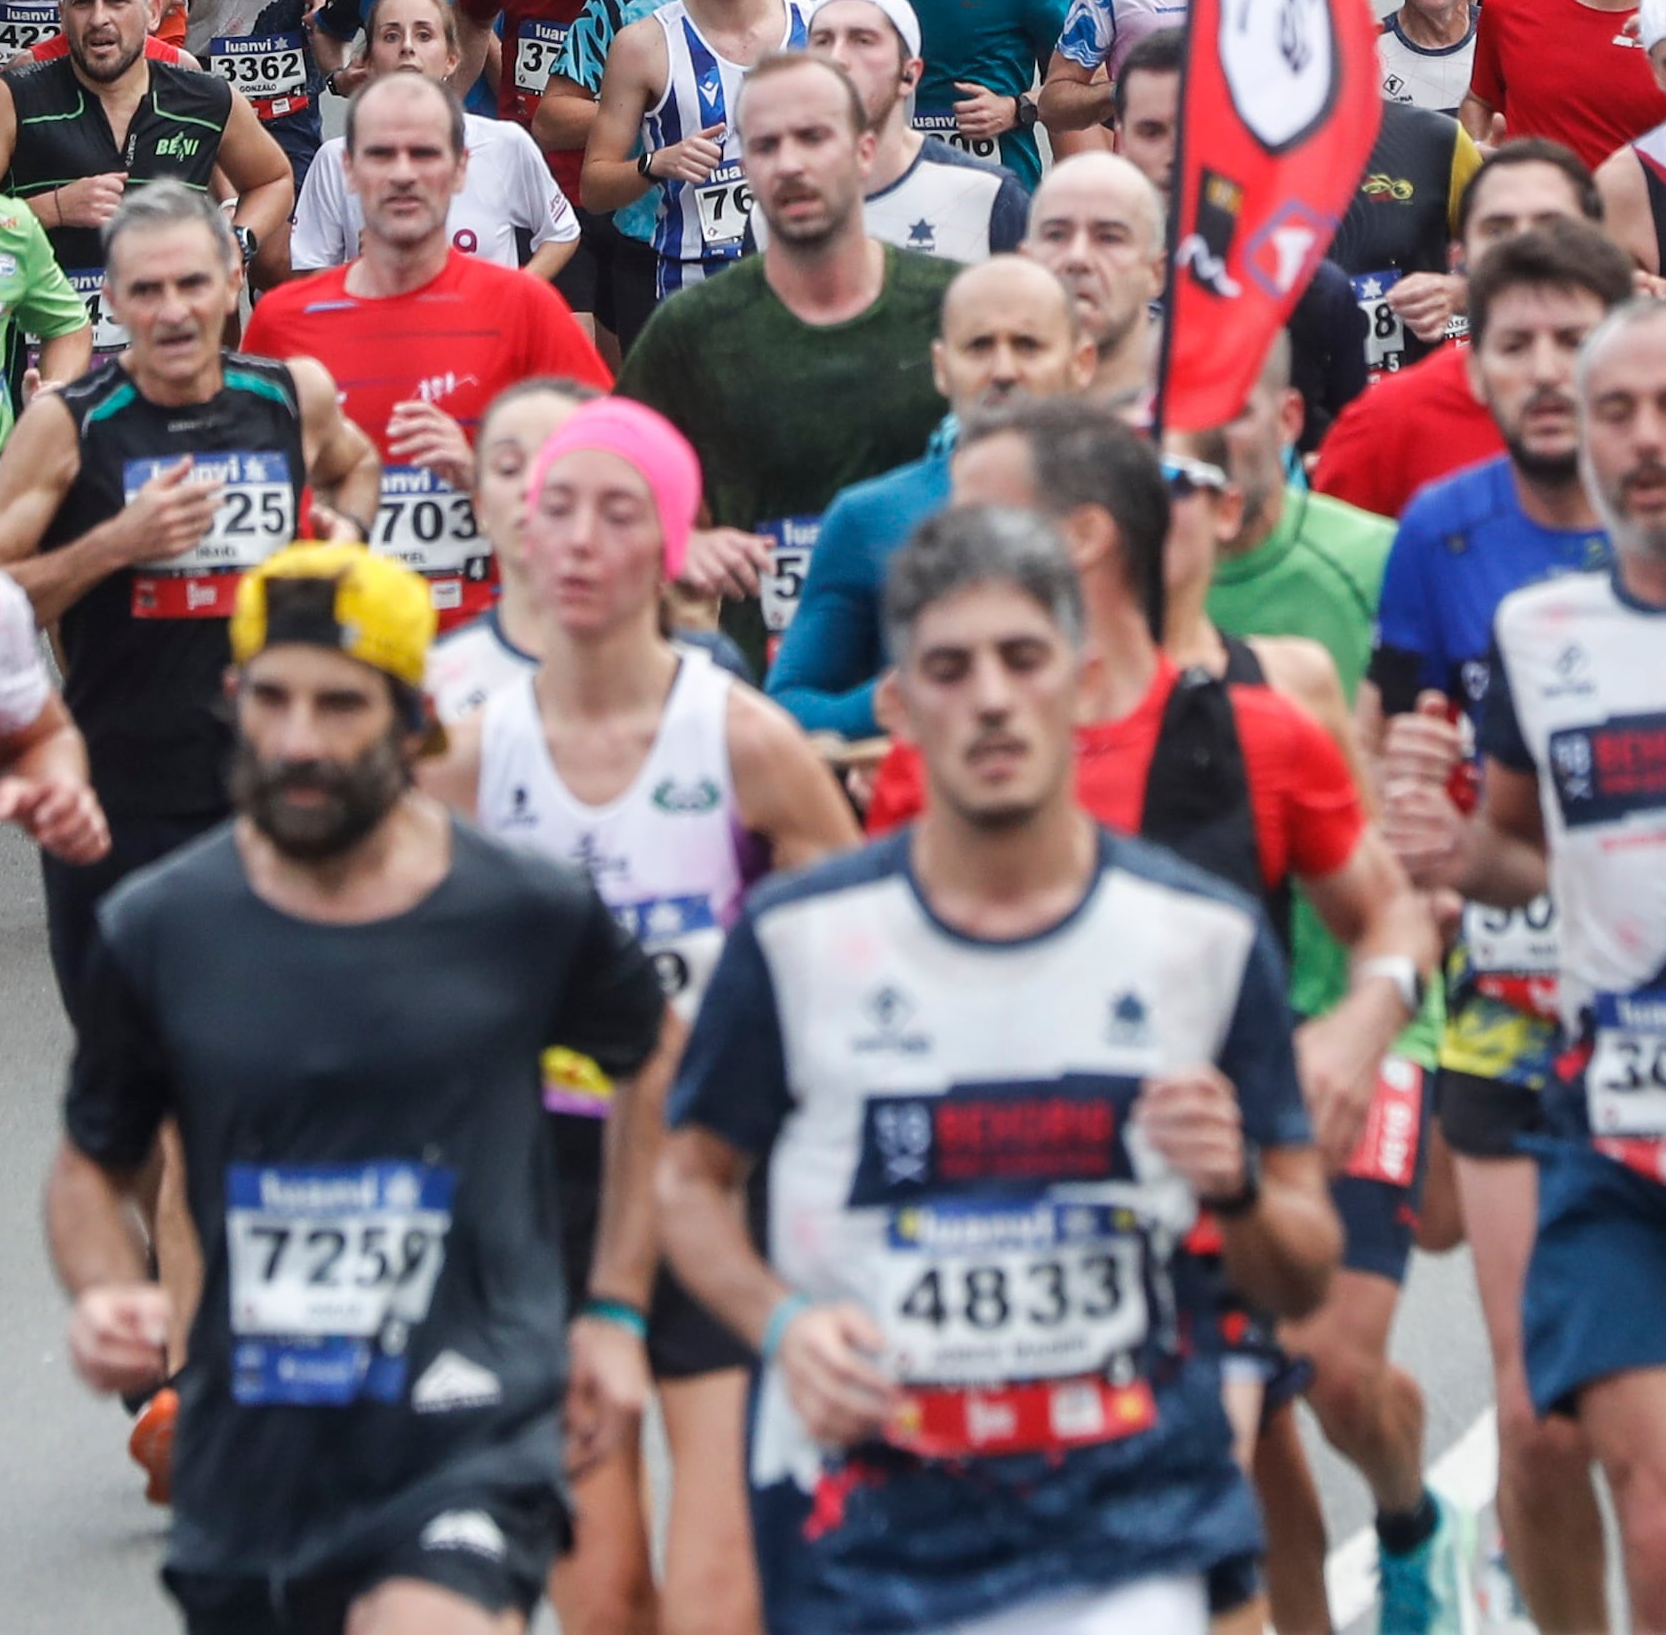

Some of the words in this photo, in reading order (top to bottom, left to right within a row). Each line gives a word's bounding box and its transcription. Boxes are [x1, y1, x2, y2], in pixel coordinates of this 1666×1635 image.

[6, 7, 55, 23] luanvi
[224, 34, 272, 53] luanvi
[218, 52, 301, 82] 3362
[239, 84, 278, 94] GONZALO
[702, 183, 754, 221] 76
[85, 295, 122, 326] 4
[207, 491, 284, 535] 25
[378, 500, 478, 545] 703
[250, 1226, 432, 1284] 7259
[900, 1255, 1121, 1330] 4833
